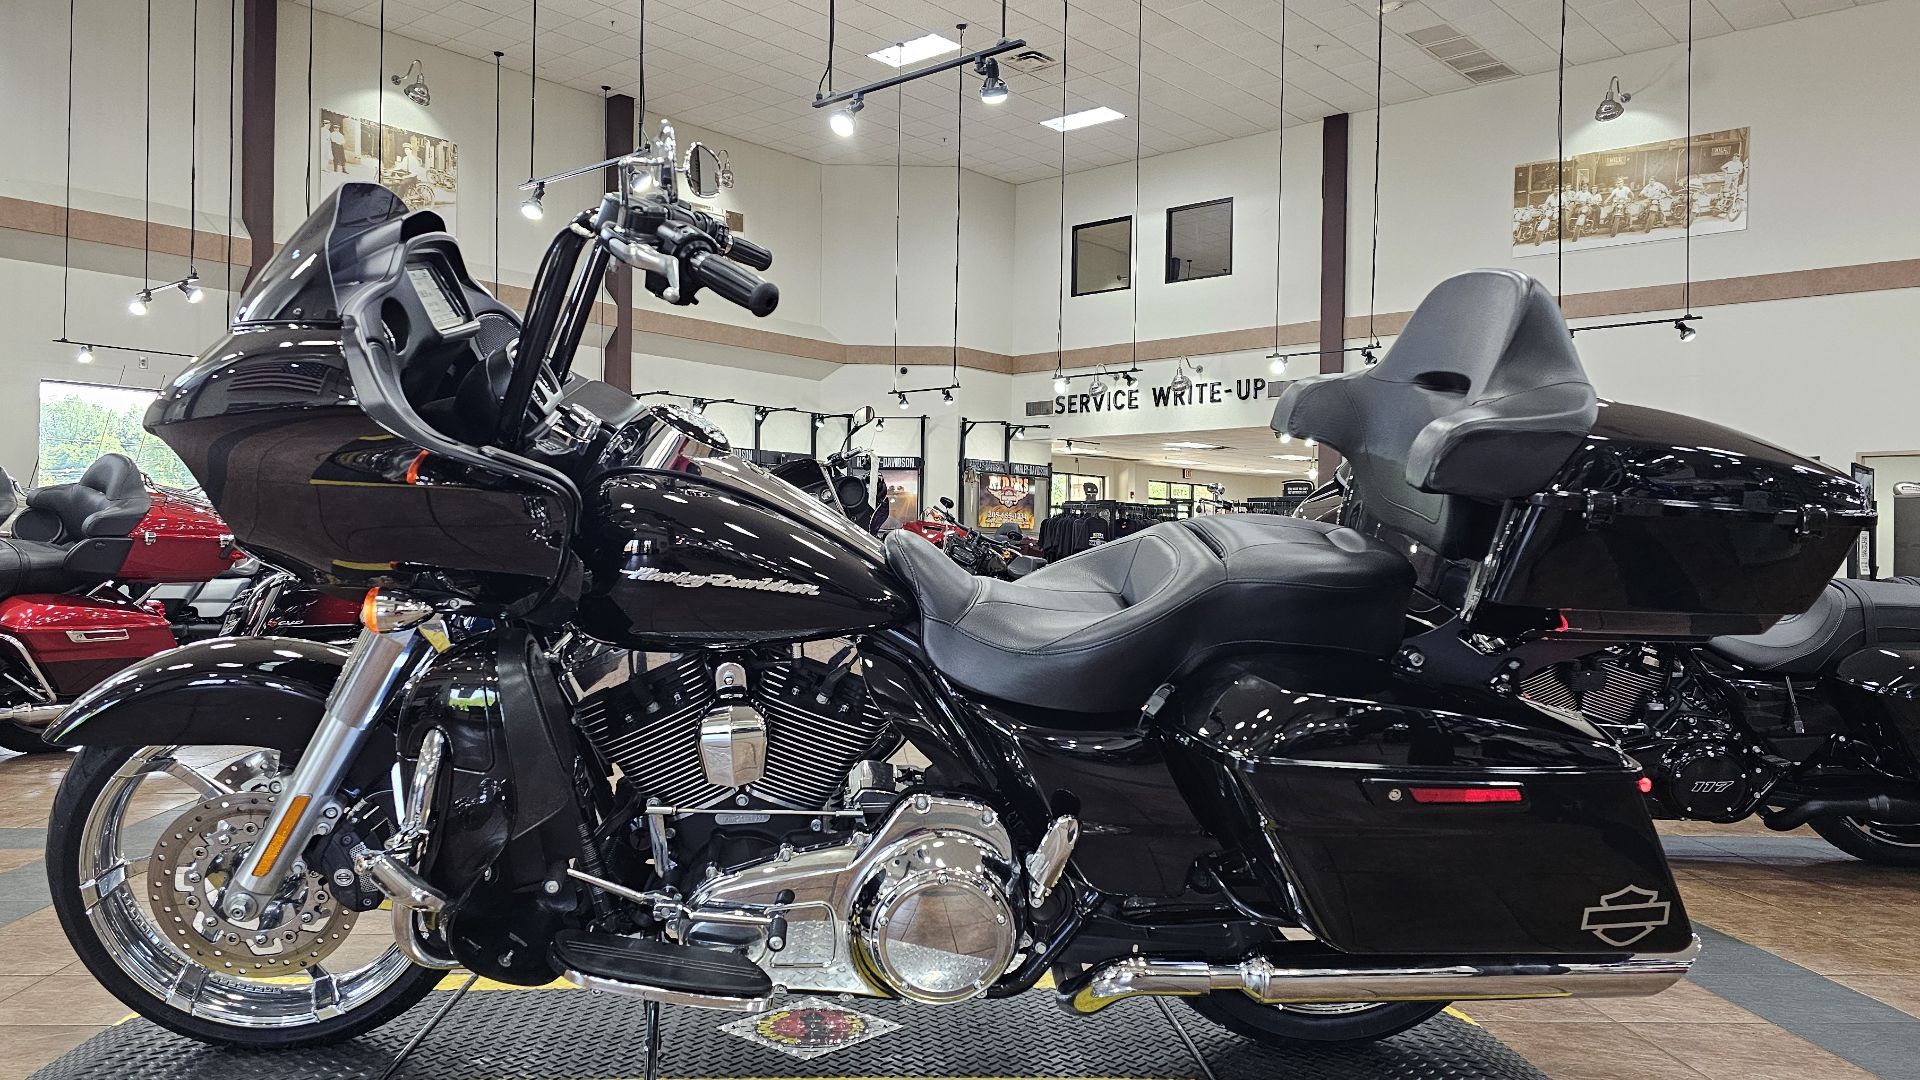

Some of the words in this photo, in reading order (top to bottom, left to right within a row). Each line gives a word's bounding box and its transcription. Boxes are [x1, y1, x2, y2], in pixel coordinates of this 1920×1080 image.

[1055, 389, 1139, 415] SERVICE
[1152, 378, 1267, 408] WRITE-UP
[1691, 780, 1735, 793] 117
